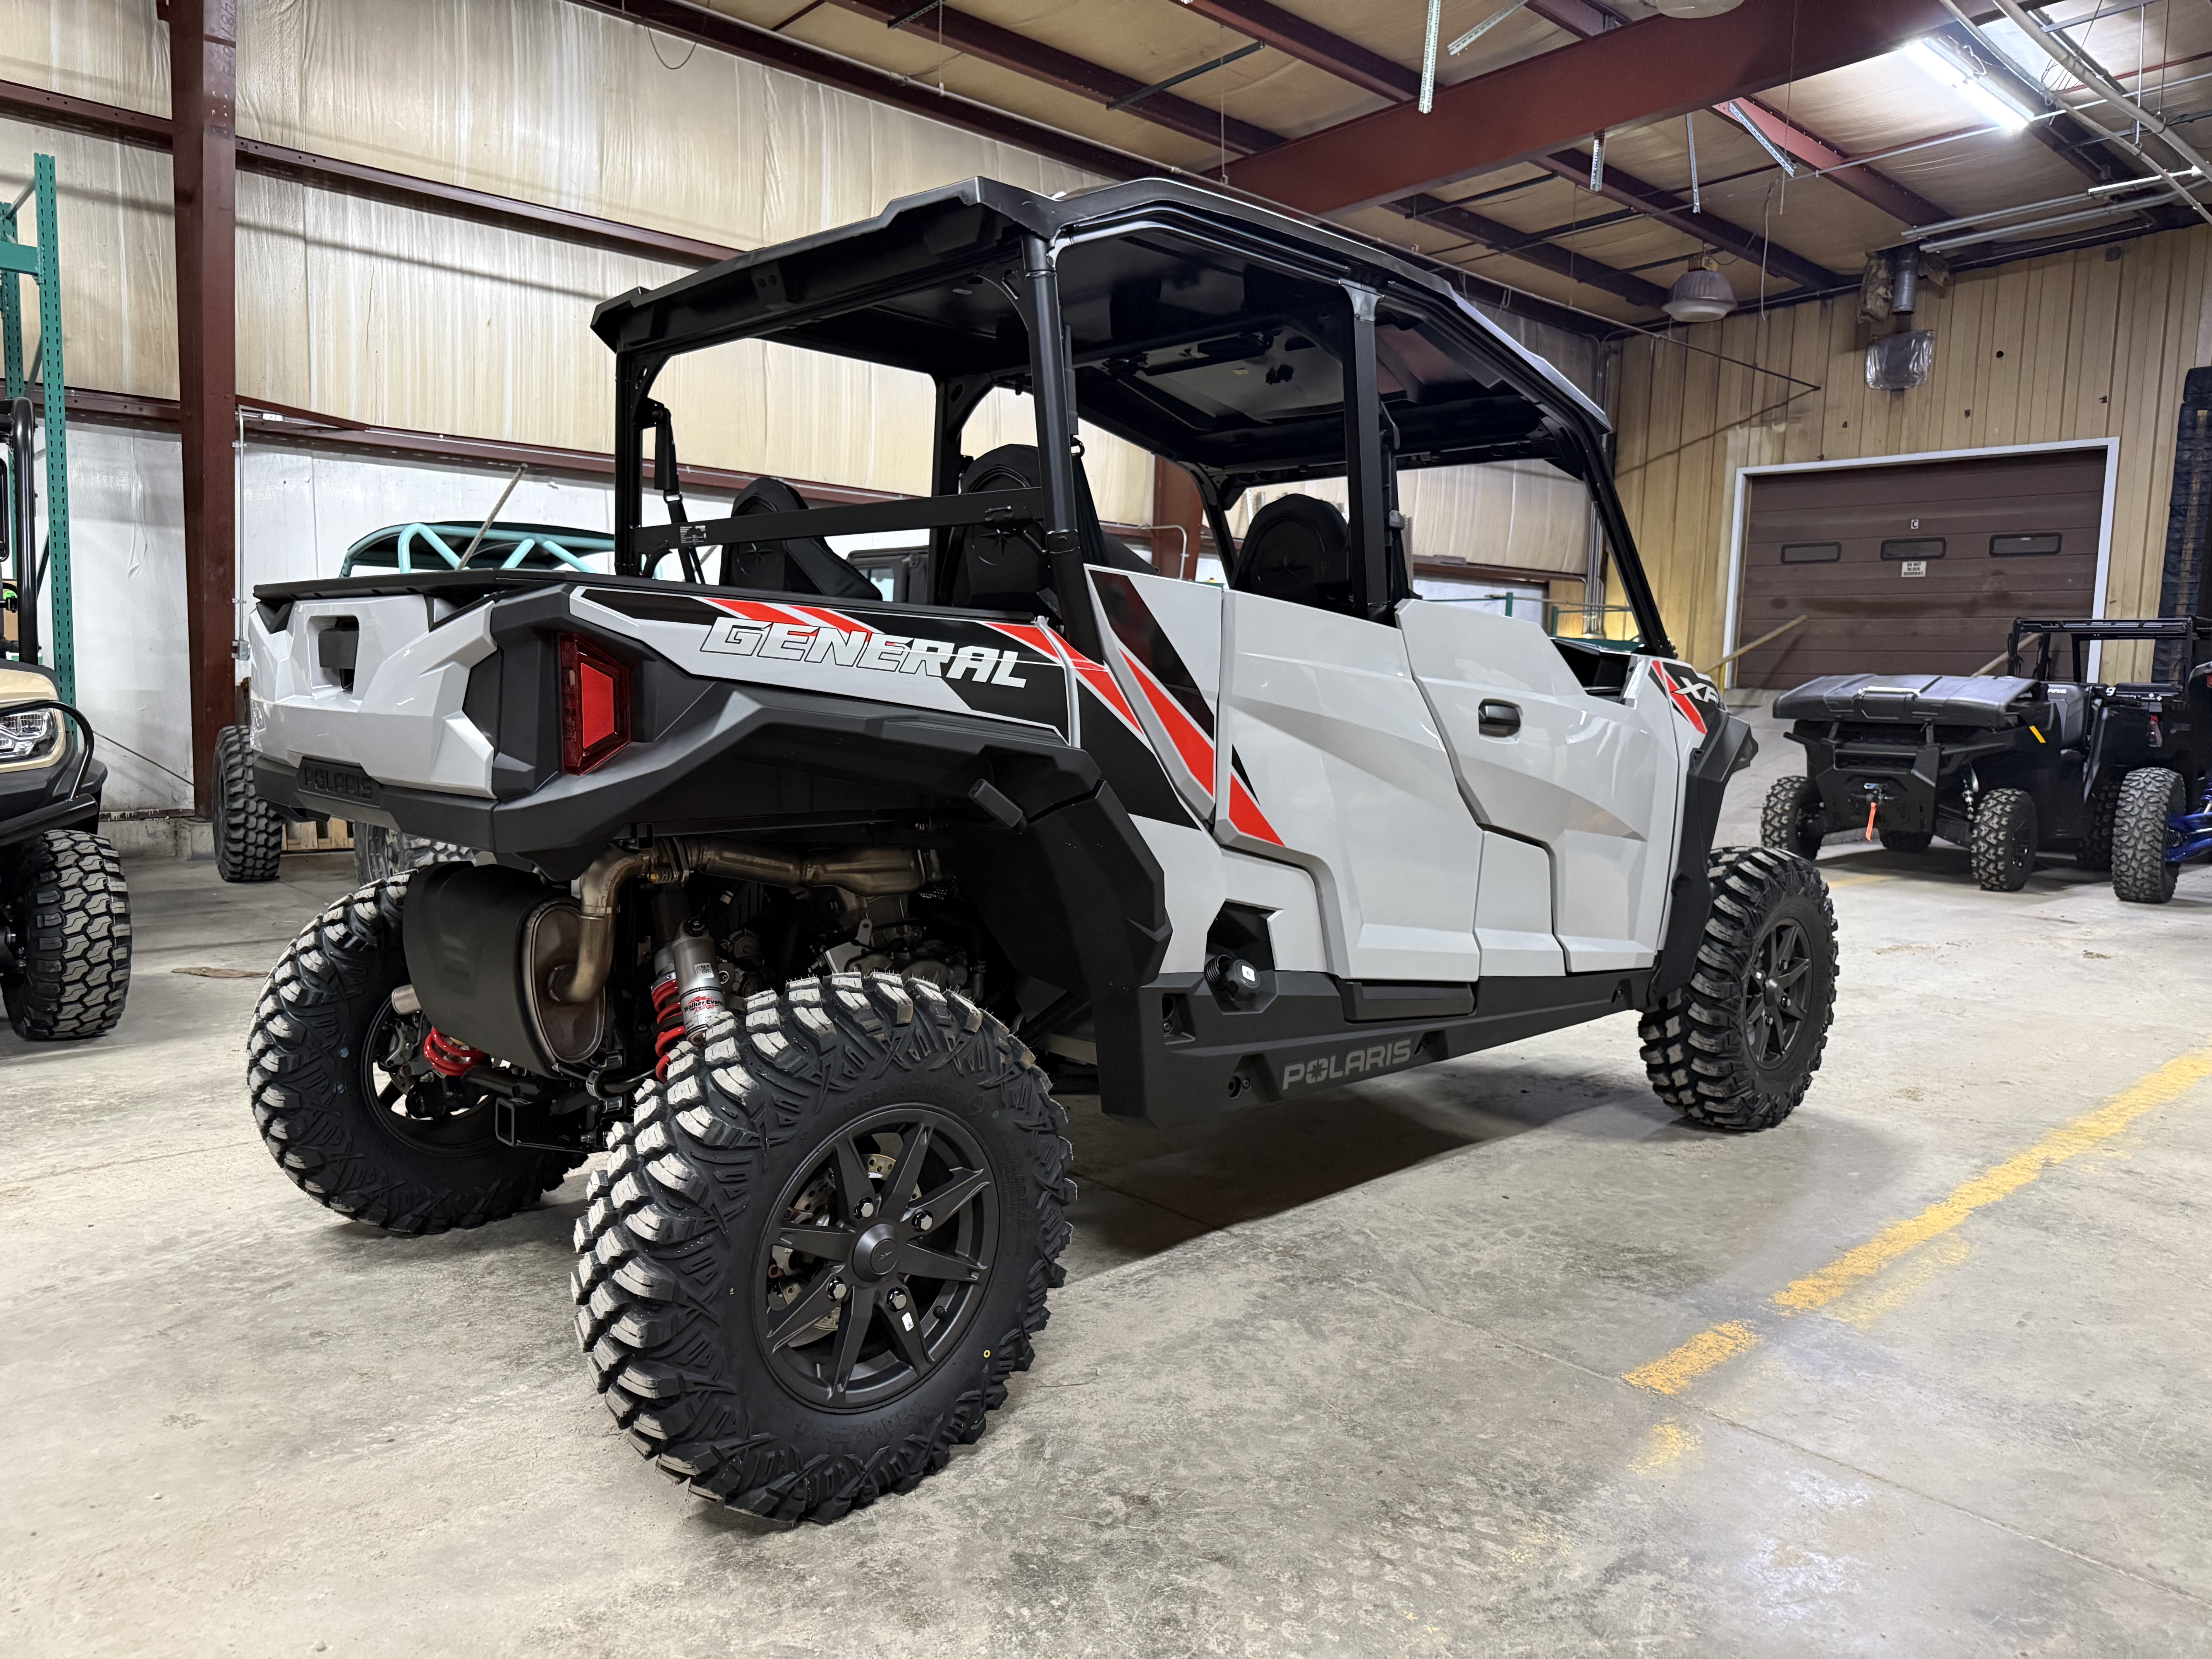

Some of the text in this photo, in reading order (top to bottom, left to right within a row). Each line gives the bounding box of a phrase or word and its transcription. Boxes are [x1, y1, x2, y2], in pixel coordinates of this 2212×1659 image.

[1912, 520, 1917, 528] C
[699, 616, 1027, 688] GENERAL
[304, 767, 372, 799] POLARIS
[684, 1001, 705, 1013] Walker
[1283, 1038, 1412, 1090] POLARIS
